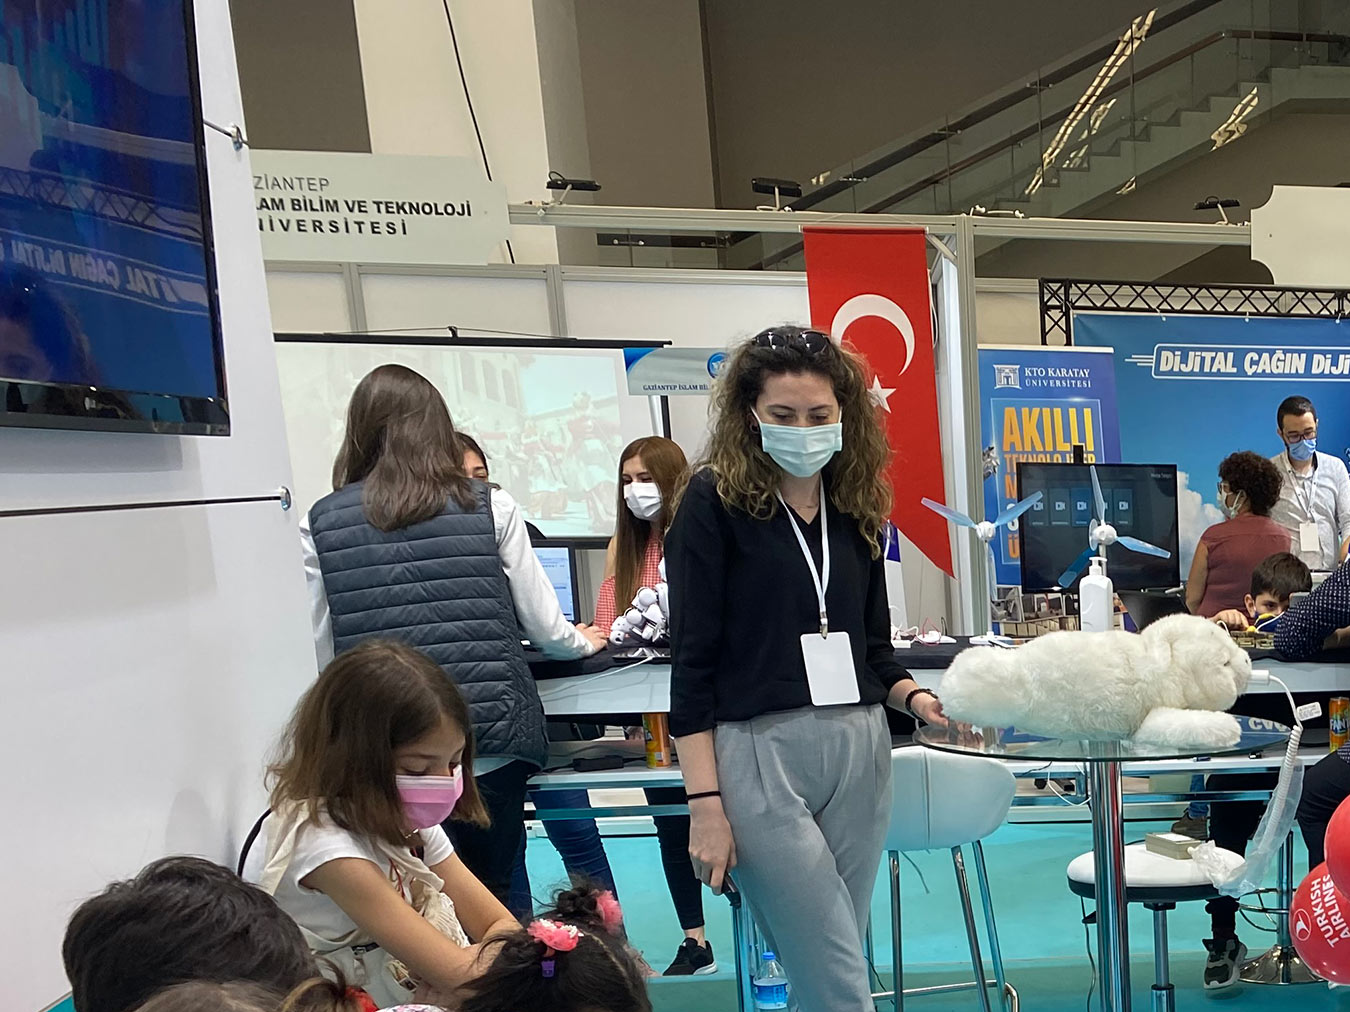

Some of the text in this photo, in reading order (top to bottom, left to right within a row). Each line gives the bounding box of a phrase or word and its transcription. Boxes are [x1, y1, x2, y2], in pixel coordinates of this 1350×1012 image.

[256, 196, 472, 217] AM BİLİM VE TEKNOLOJİ
[1025, 367, 1090, 378] KTO KARATAY
[1243, 350, 1306, 376] ÇAĞIN
[1025, 379, 1092, 388] ÜNİVERSİTESİ
[1003, 407, 1095, 452] AKILLI
[1310, 878, 1340, 948] TURKISH
